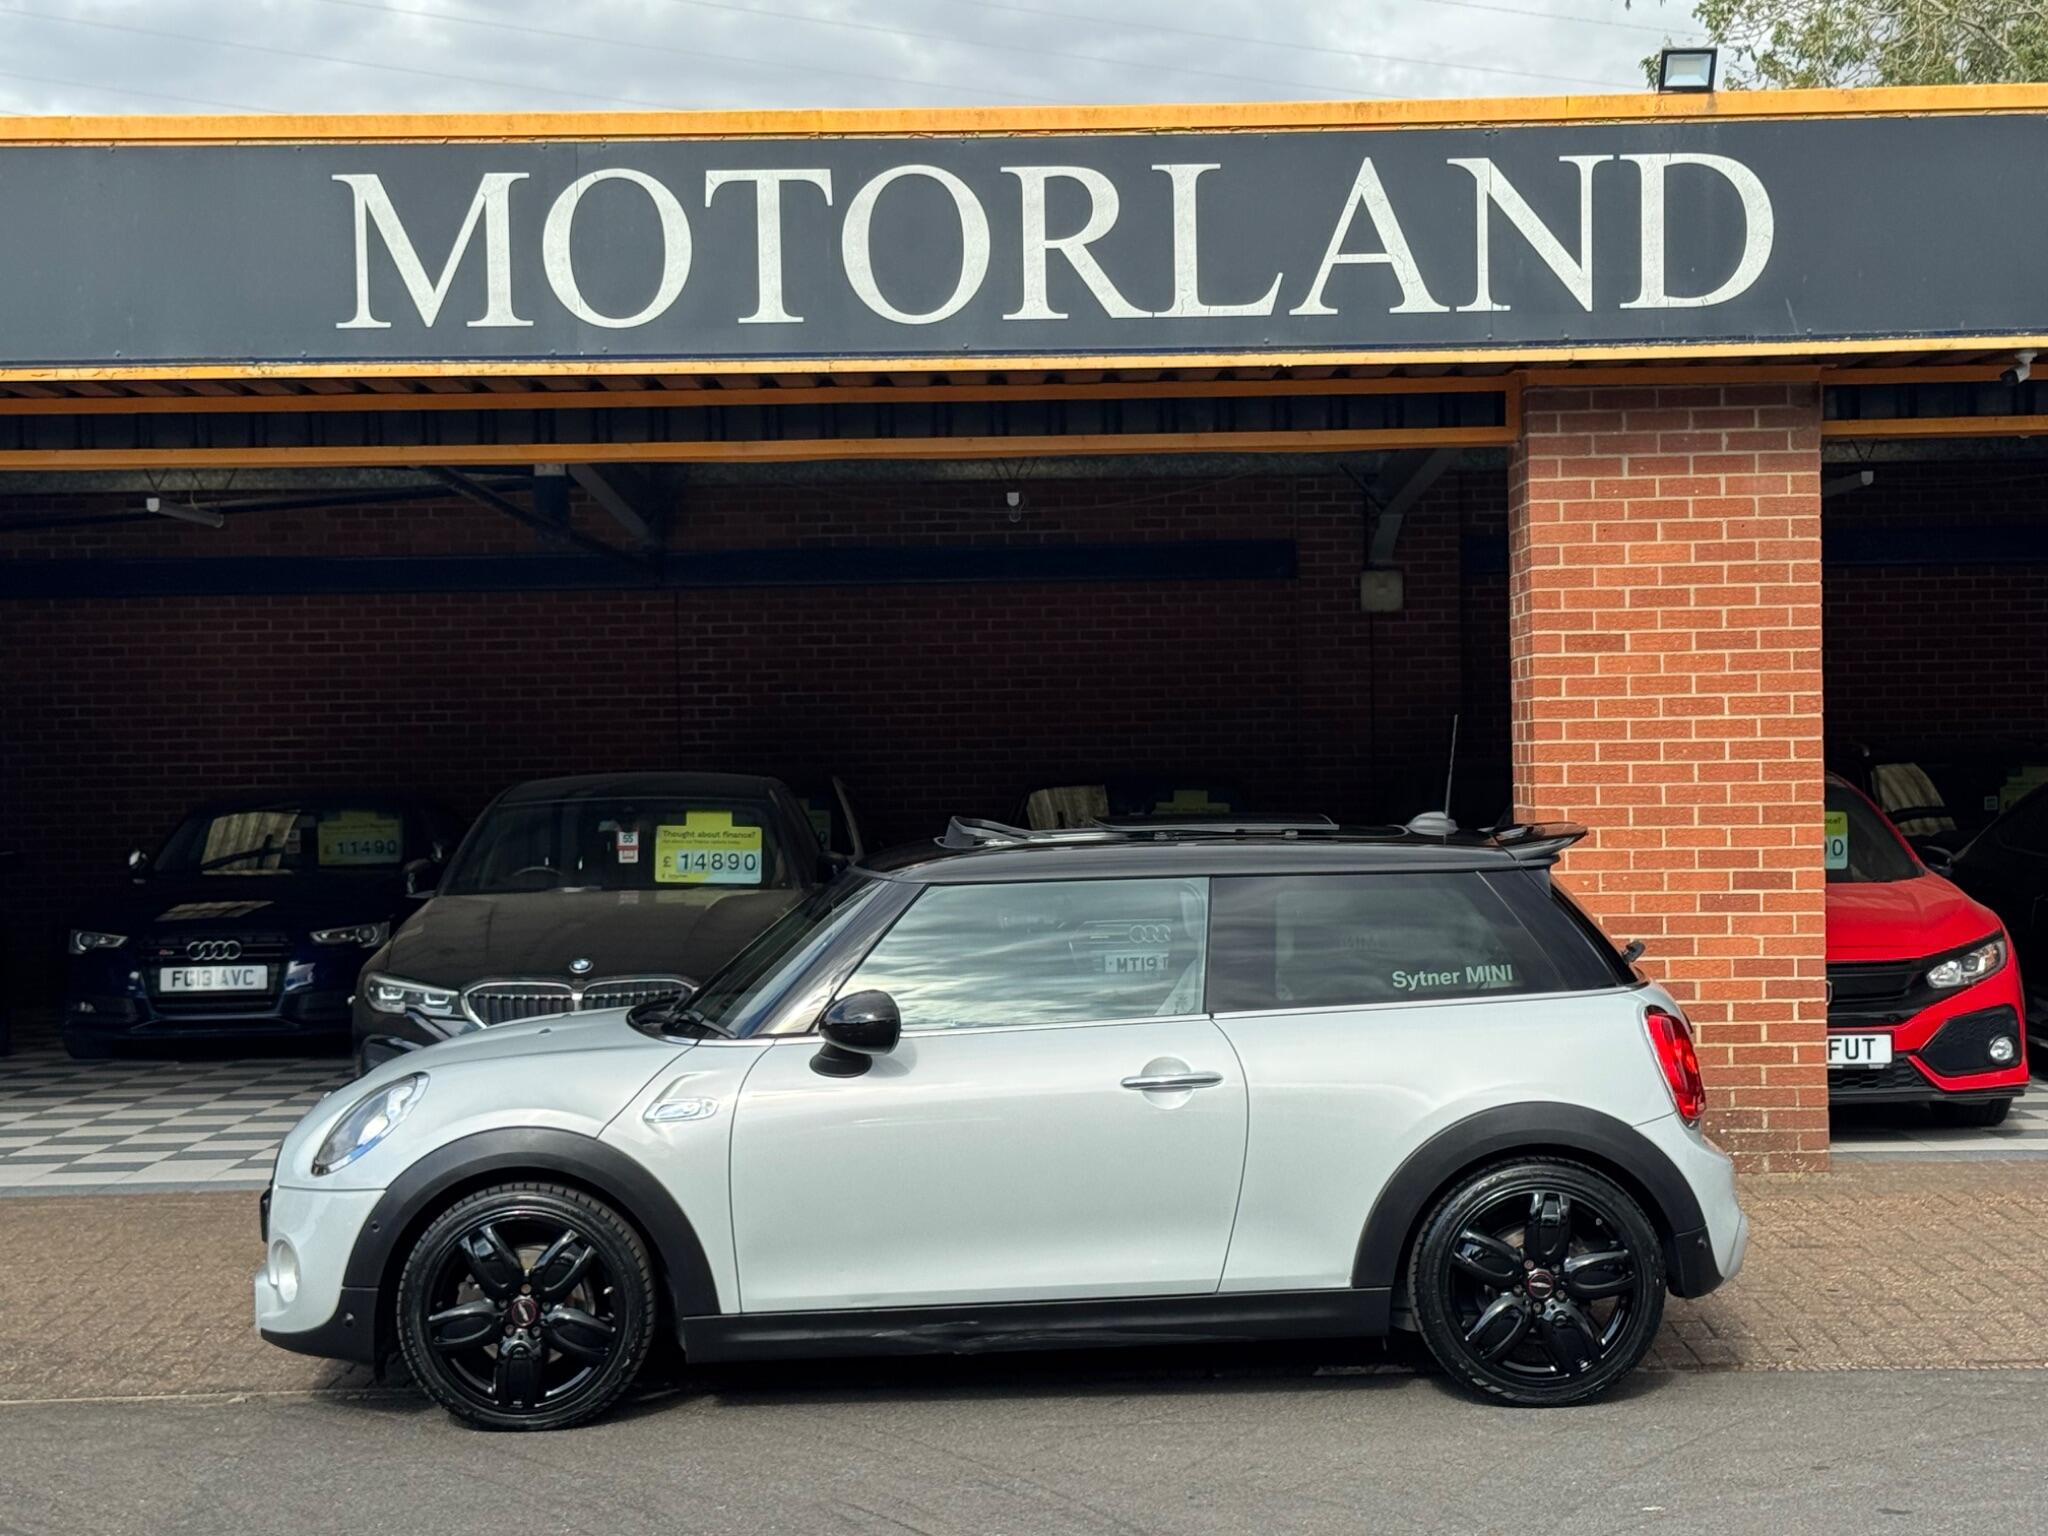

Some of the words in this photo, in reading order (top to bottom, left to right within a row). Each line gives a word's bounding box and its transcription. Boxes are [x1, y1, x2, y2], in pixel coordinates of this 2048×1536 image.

[331, 153, 1775, 330] MOTORLAND
[662, 830, 695, 839] Thought
[697, 830, 720, 838] about
[337, 839, 397, 855] 11490
[680, 852, 757, 871] 14890
[218, 969, 254, 986] AVC
[1392, 969, 1461, 992] Sytner
[1466, 964, 1513, 984] MINI
[1828, 1037, 1876, 1060] FUT
